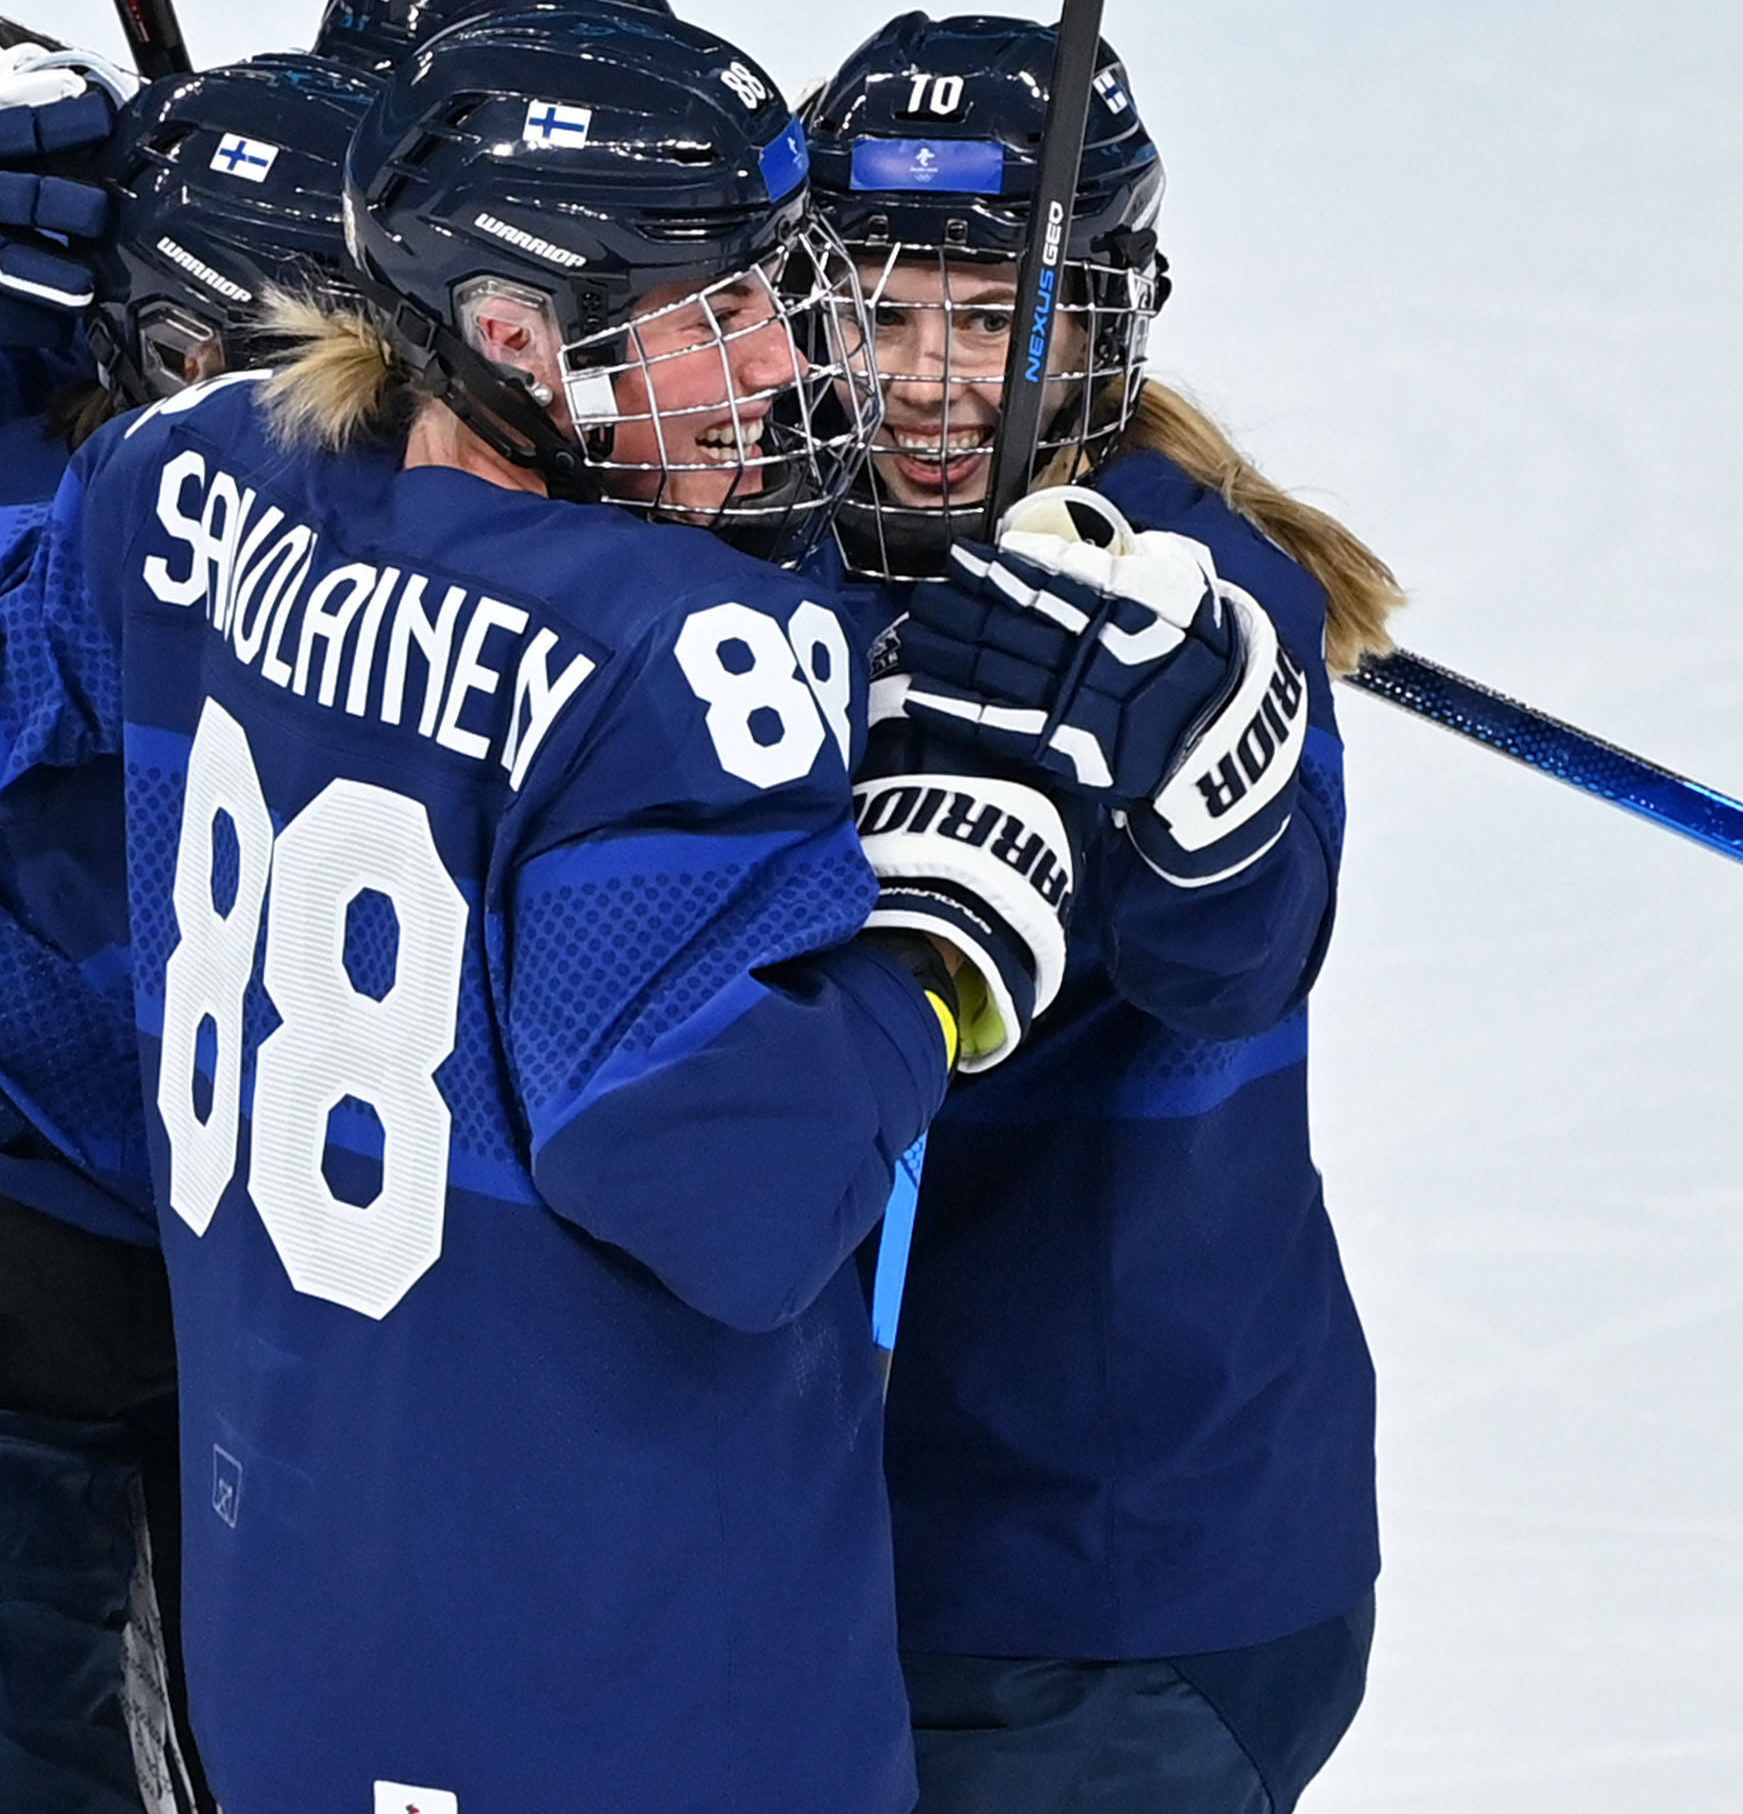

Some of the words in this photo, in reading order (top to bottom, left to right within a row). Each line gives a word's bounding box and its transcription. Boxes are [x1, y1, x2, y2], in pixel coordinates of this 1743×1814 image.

[720, 61, 767, 109] 88
[907, 74, 964, 115] 10
[157, 236, 253, 302] WARRIOR
[474, 213, 587, 267] WARRIOR
[1025, 268, 1055, 383] NEXUS
[1043, 201, 1064, 267] GEO
[143, 449, 595, 793] SAVOLAINEN
[1195, 647, 1305, 818] RIOR
[854, 787, 1074, 931] ARRIO
[157, 696, 469, 1320] 88
